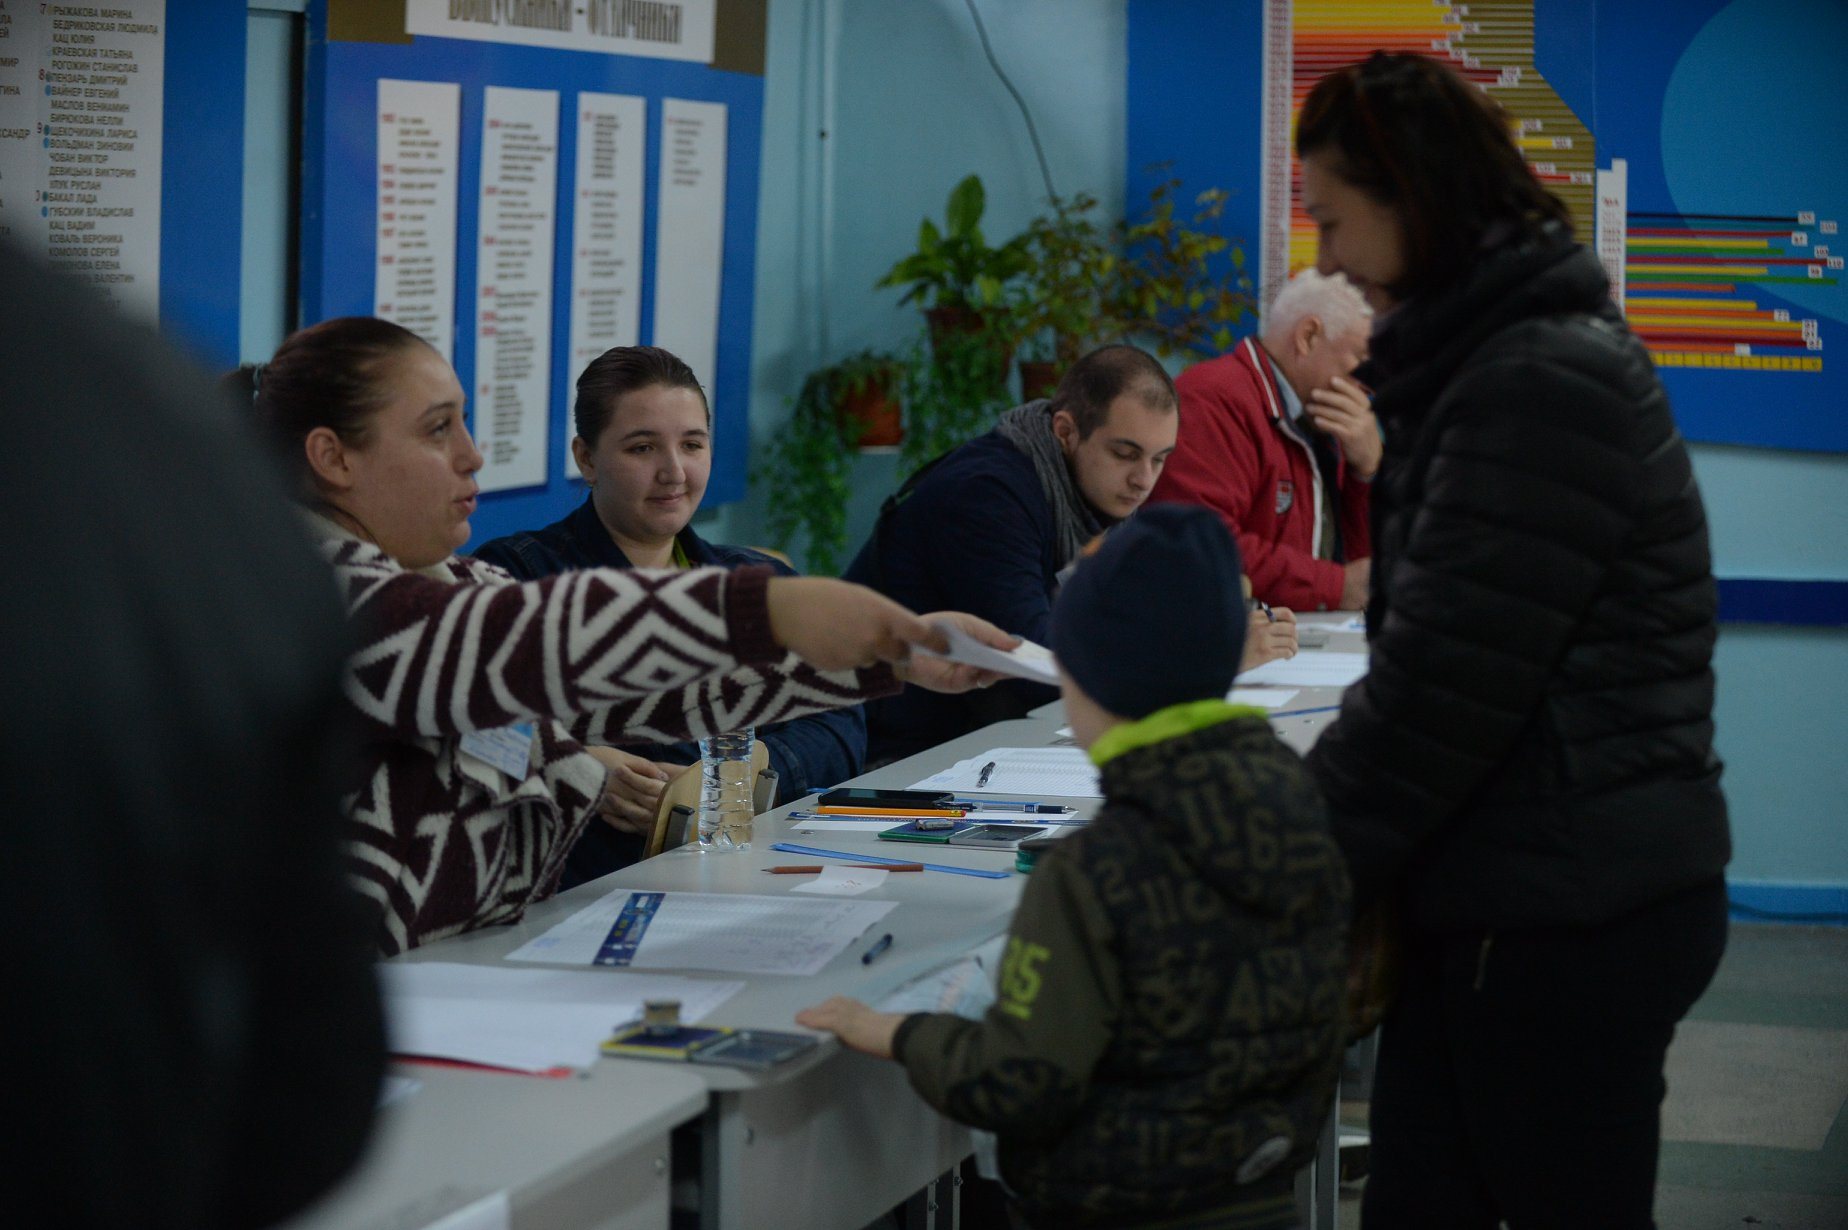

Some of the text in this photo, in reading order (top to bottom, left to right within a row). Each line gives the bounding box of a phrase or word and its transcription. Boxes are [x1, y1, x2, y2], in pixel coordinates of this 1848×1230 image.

[54, 6, 133, 19] РЫЖАКОВА МАРИНА
[117, 24, 159, 35] ЛЮДМИЛА
[70, 35, 95, 44] ЮЛИЯ
[52, 47, 134, 60] КРАЕВСКАЯ ТАТЬЯНА
[52, 60, 138, 73] РОГОЖИН СТАНИСЛАВ
[89, 74, 128, 86] ДМИТРИЙ
[84, 86, 120, 98] ЕВГЕНИЙ
[51, 99, 85, 111] МАСЛОВ
[50, 113, 94, 125] БИРЮКОВА
[106, 129, 138, 139] ЛАРИСА
[78, 153, 109, 164] ВИКТОР
[95, 168, 136, 178] ВИКТОРИЯ
[71, 180, 102, 190] РУСЛАН
[87, 207, 134, 218] ВЛАДИСЛАВ
[67, 221, 95, 231] ВАДИМ
[50, 234, 123, 244] КОВАЛЬ ВЕРОНИКА
[90, 246, 120, 257] СЕРГЕЙ
[95, 261, 121, 270] ЕЛЕНА
